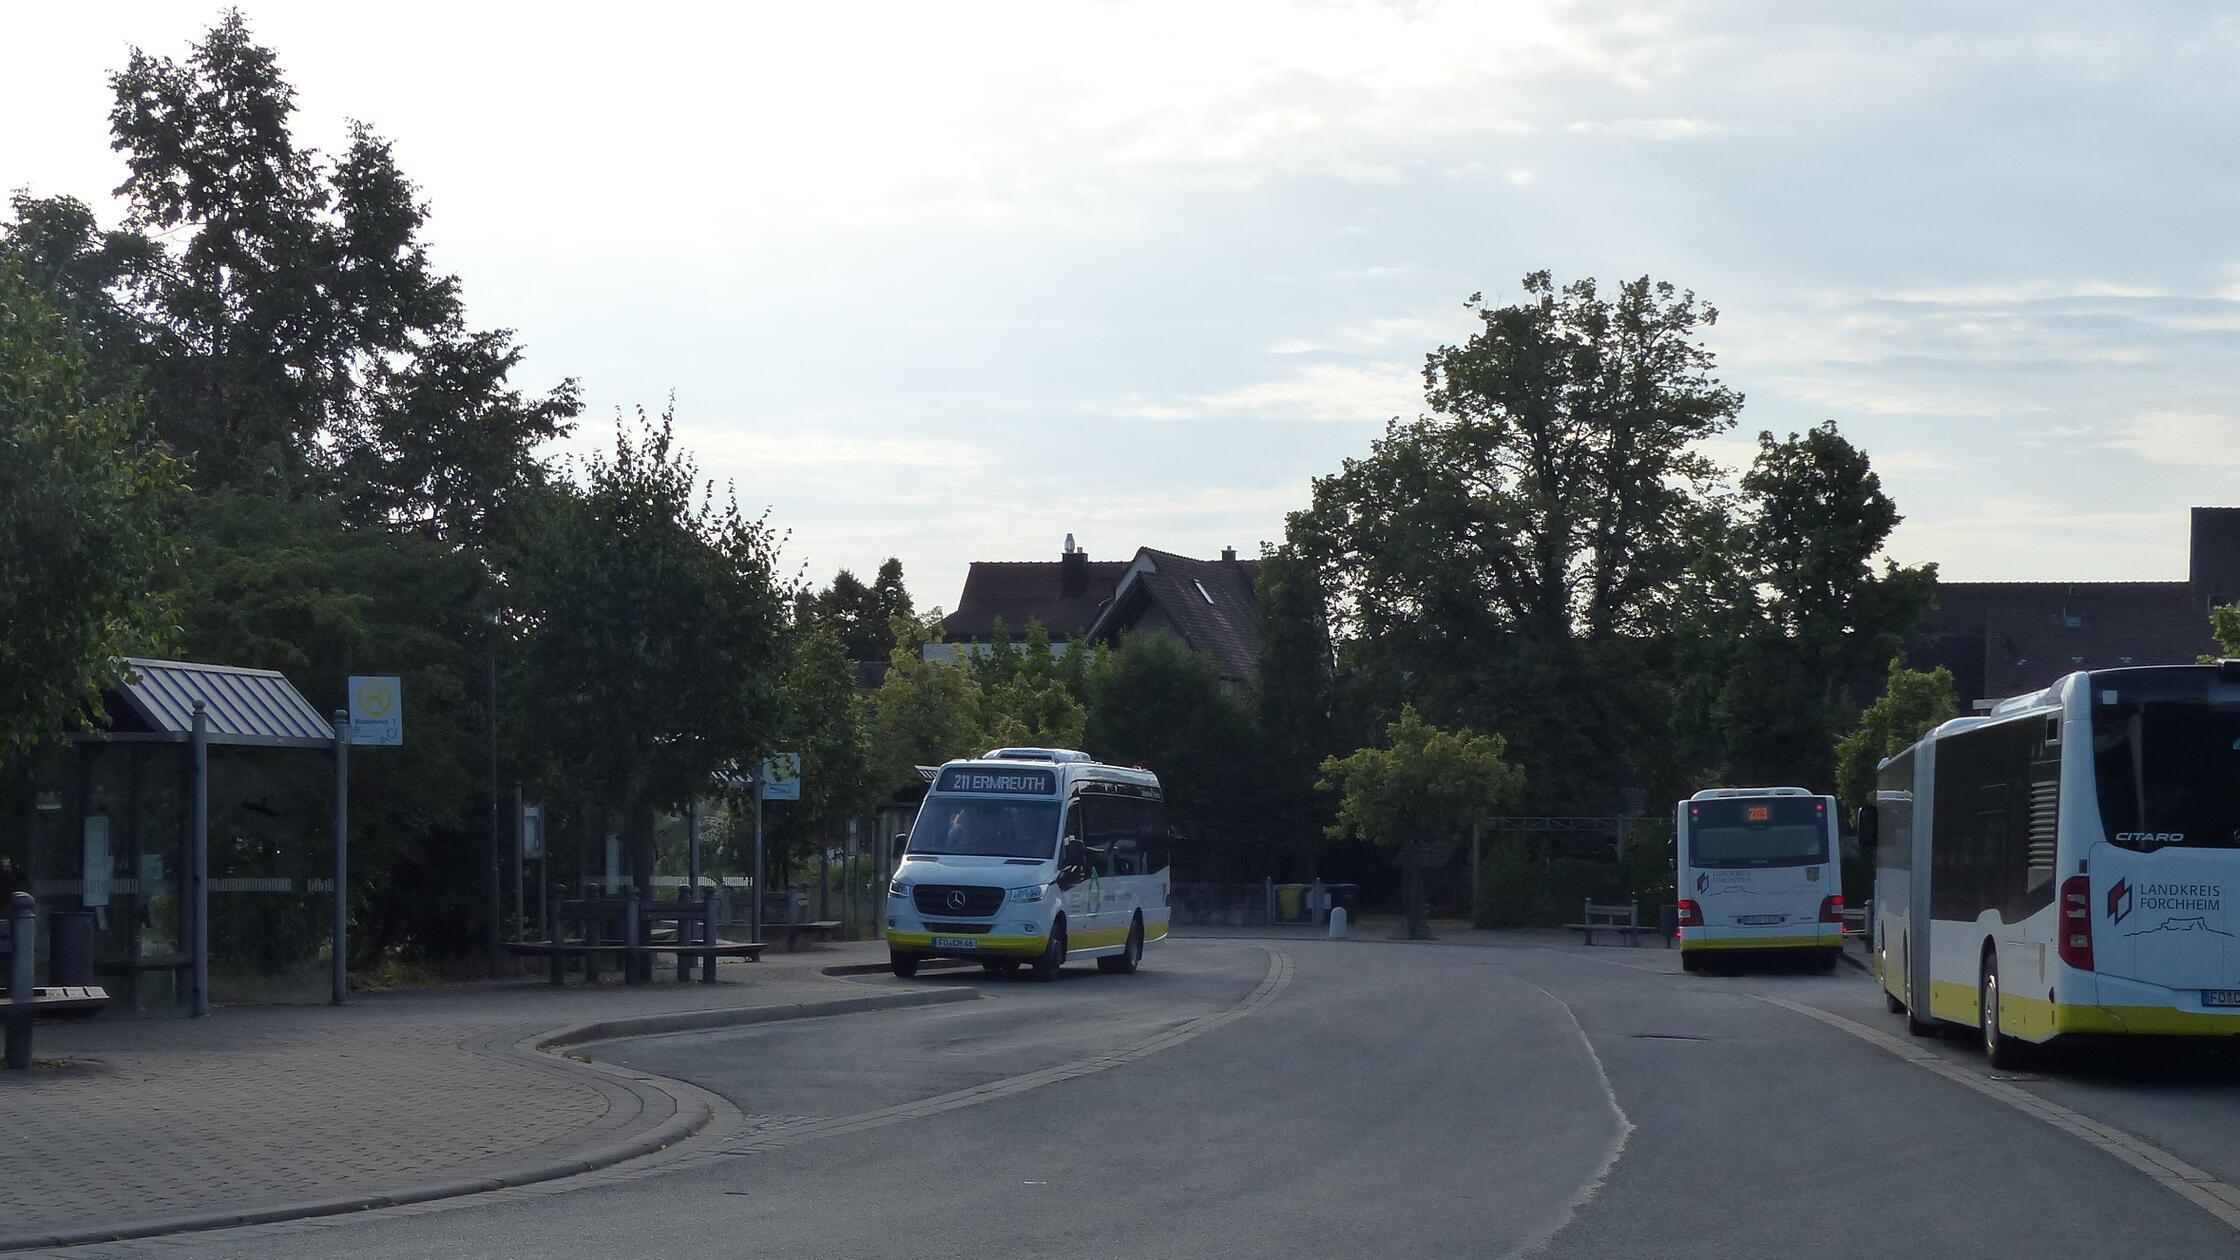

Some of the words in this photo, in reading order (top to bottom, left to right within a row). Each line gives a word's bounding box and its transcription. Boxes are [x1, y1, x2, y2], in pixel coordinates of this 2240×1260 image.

[954, 774, 970, 790] 211
[972, 775, 1046, 791] ERMREUTH
[2115, 832, 2185, 842] CITARO
[2139, 883, 2221, 897] LANDKREIS
[2139, 897, 2221, 911] FORCHHEIM
[2210, 991, 2226, 1003] FO
